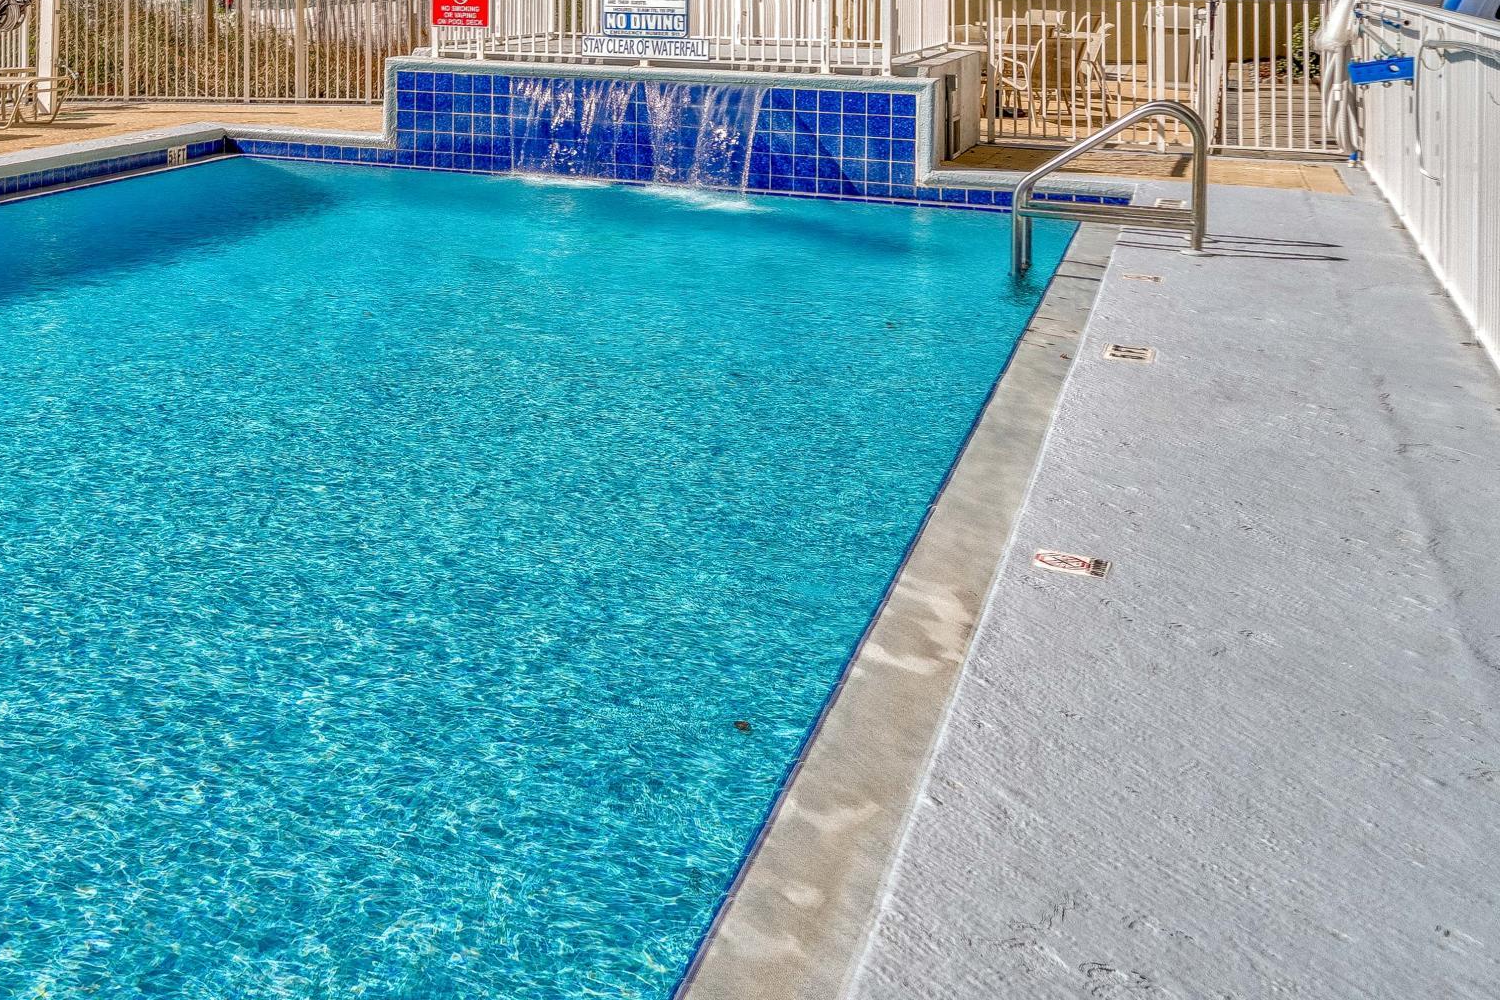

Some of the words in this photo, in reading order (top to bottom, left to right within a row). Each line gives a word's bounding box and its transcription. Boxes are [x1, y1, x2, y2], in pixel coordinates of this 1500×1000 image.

[452, 5, 480, 13] SMOKING
[606, 13, 627, 29] NO
[630, 13, 684, 31] DIVING
[583, 38, 605, 53] STAY
[606, 39, 635, 55] CLEAR
[636, 40, 650, 55] OF
[651, 40, 707, 57] WATERFALL
